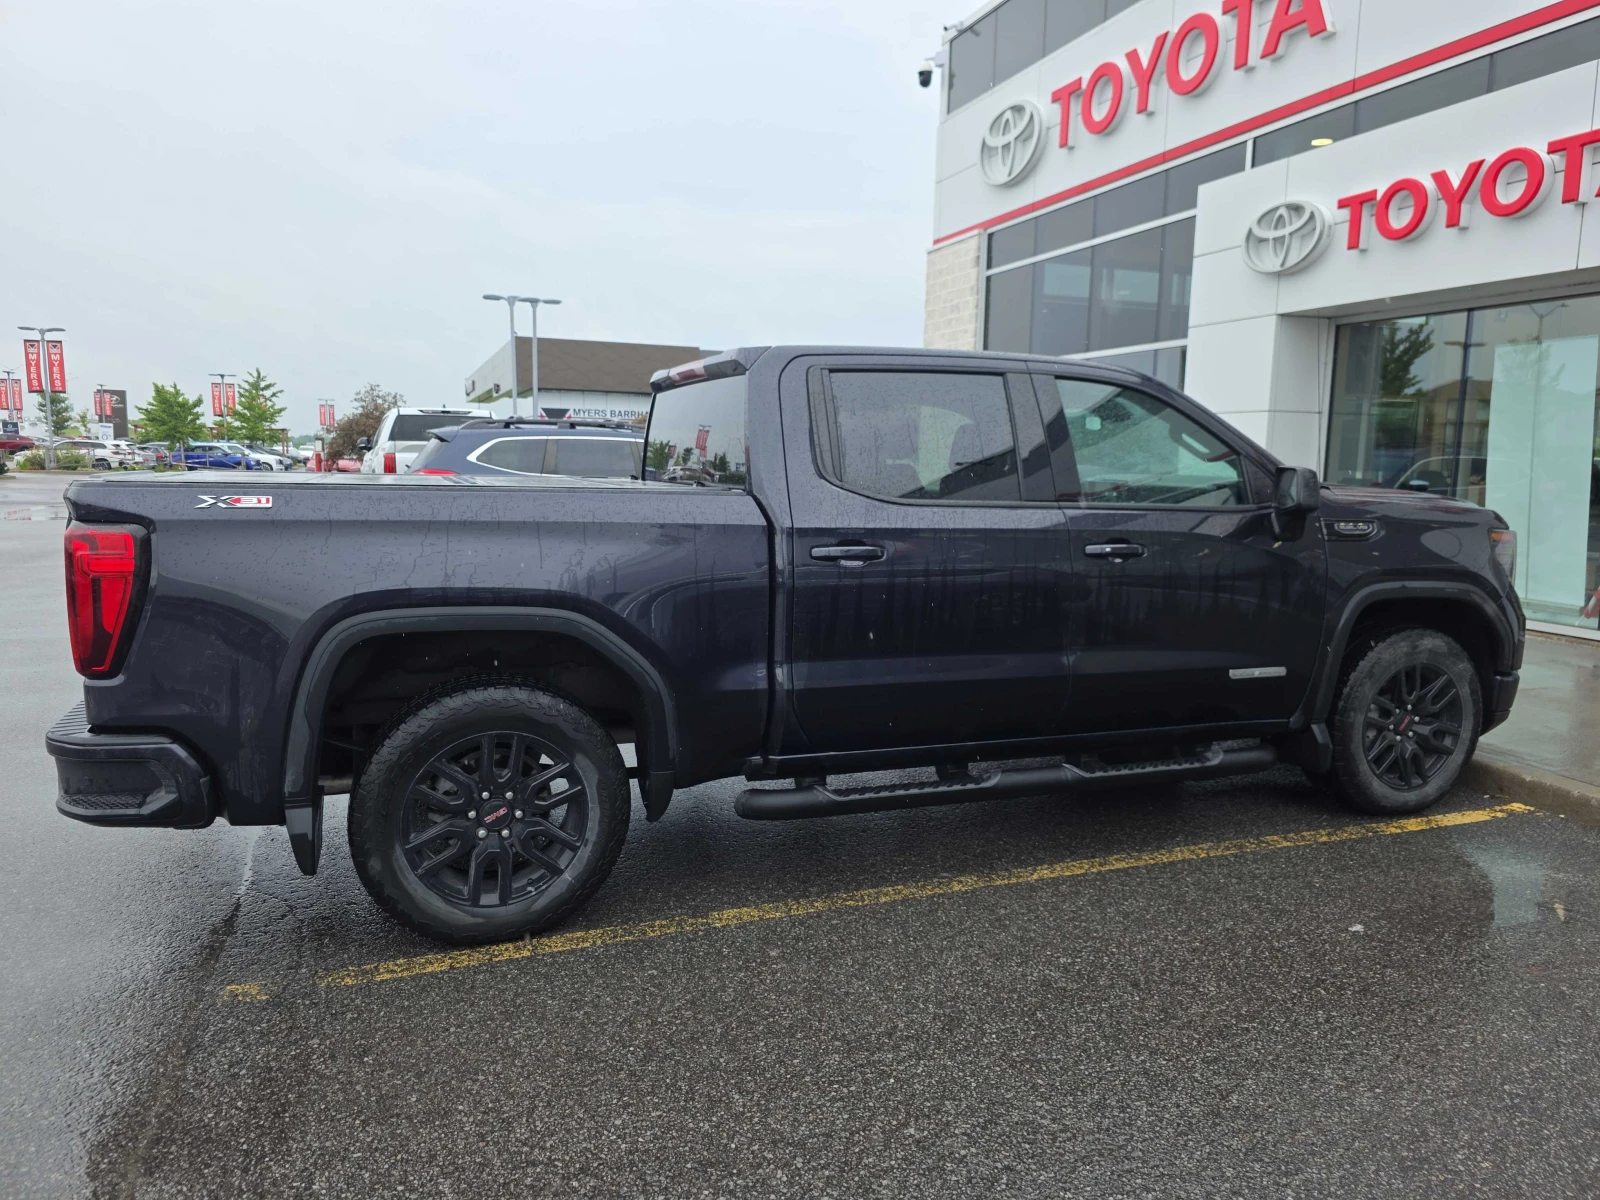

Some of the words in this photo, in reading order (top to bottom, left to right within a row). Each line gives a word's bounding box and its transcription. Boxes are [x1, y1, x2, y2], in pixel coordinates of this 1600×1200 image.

[1051, 0, 1330, 149] TOYOTA
[1337, 128, 1600, 250] TOYOT
[28, 353, 39, 387] MYERS
[51, 353, 62, 387] MYERS
[573, 408, 607, 418] MYERS
[484, 806, 508, 823] GMC
